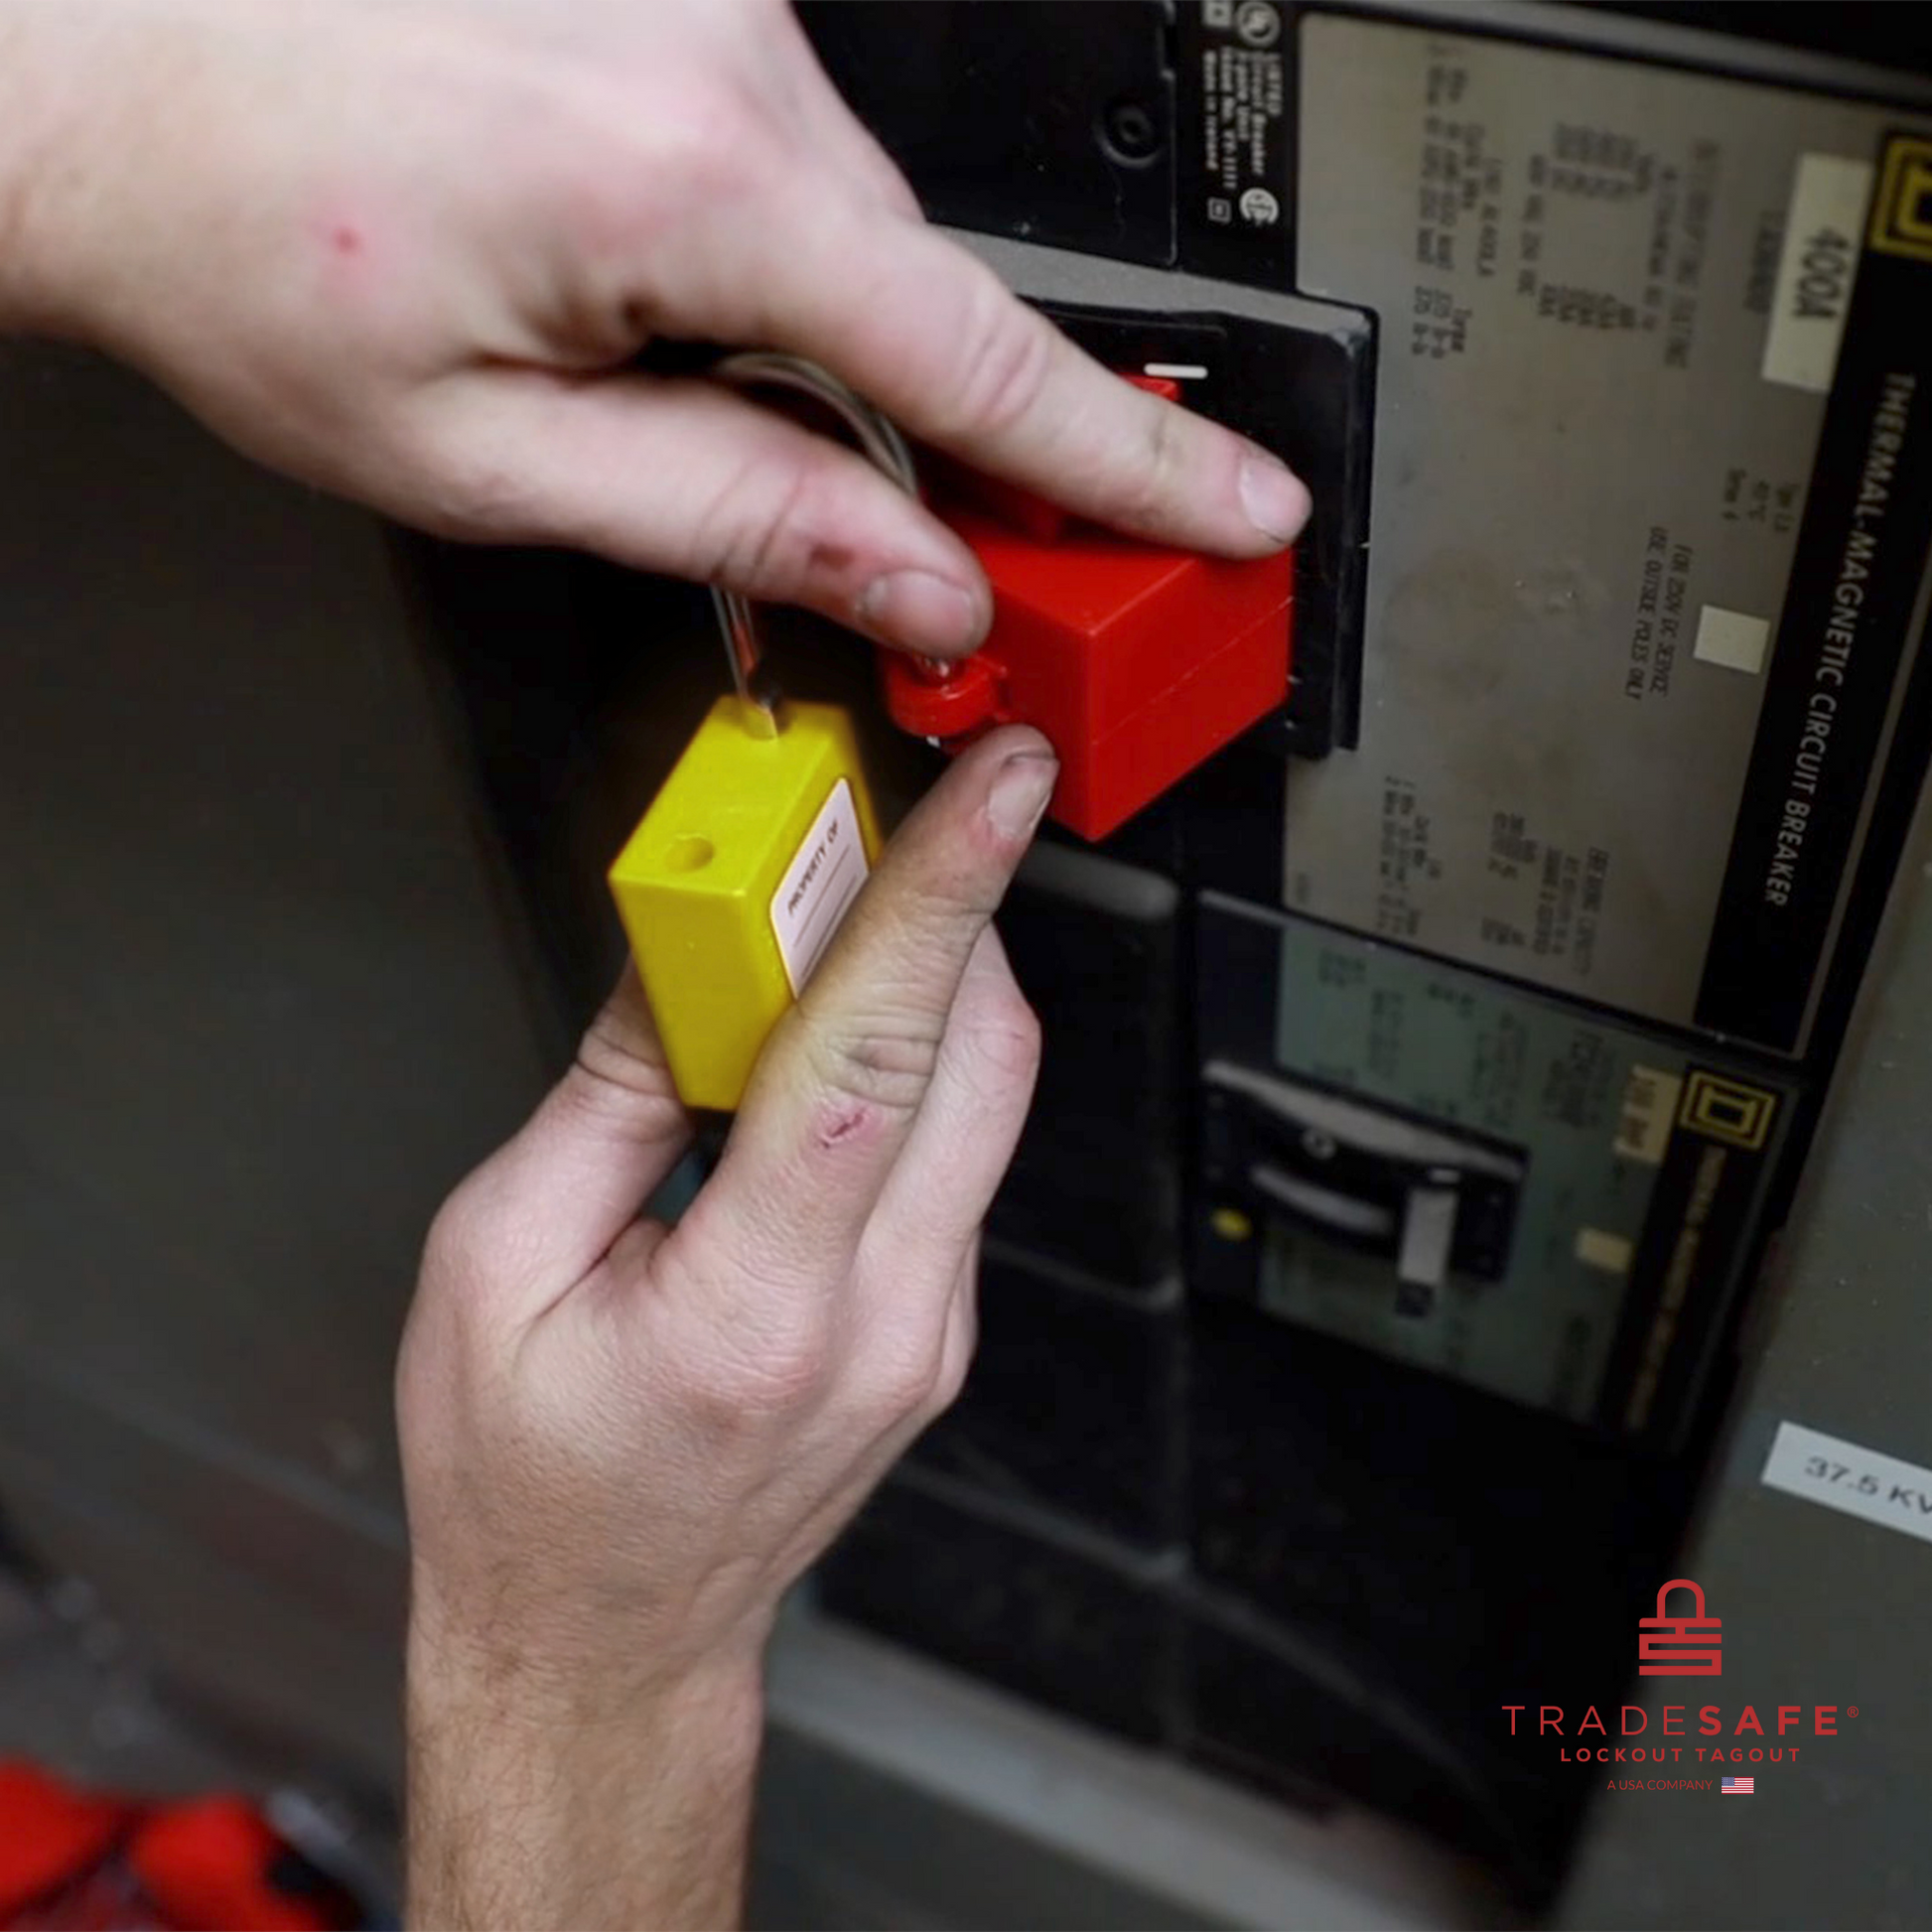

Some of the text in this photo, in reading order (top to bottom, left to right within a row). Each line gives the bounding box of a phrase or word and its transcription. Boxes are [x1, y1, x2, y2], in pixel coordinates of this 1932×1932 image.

[1251, 112, 1267, 176] Breaker
[1792, 224, 1850, 320] 400A
[1764, 372, 1916, 906] THERMAL-MAGNETIC CIRCUIT BREAKER
[787, 818, 840, 916] PROPERTY OF
[1805, 1455, 1879, 1496] 37.5
